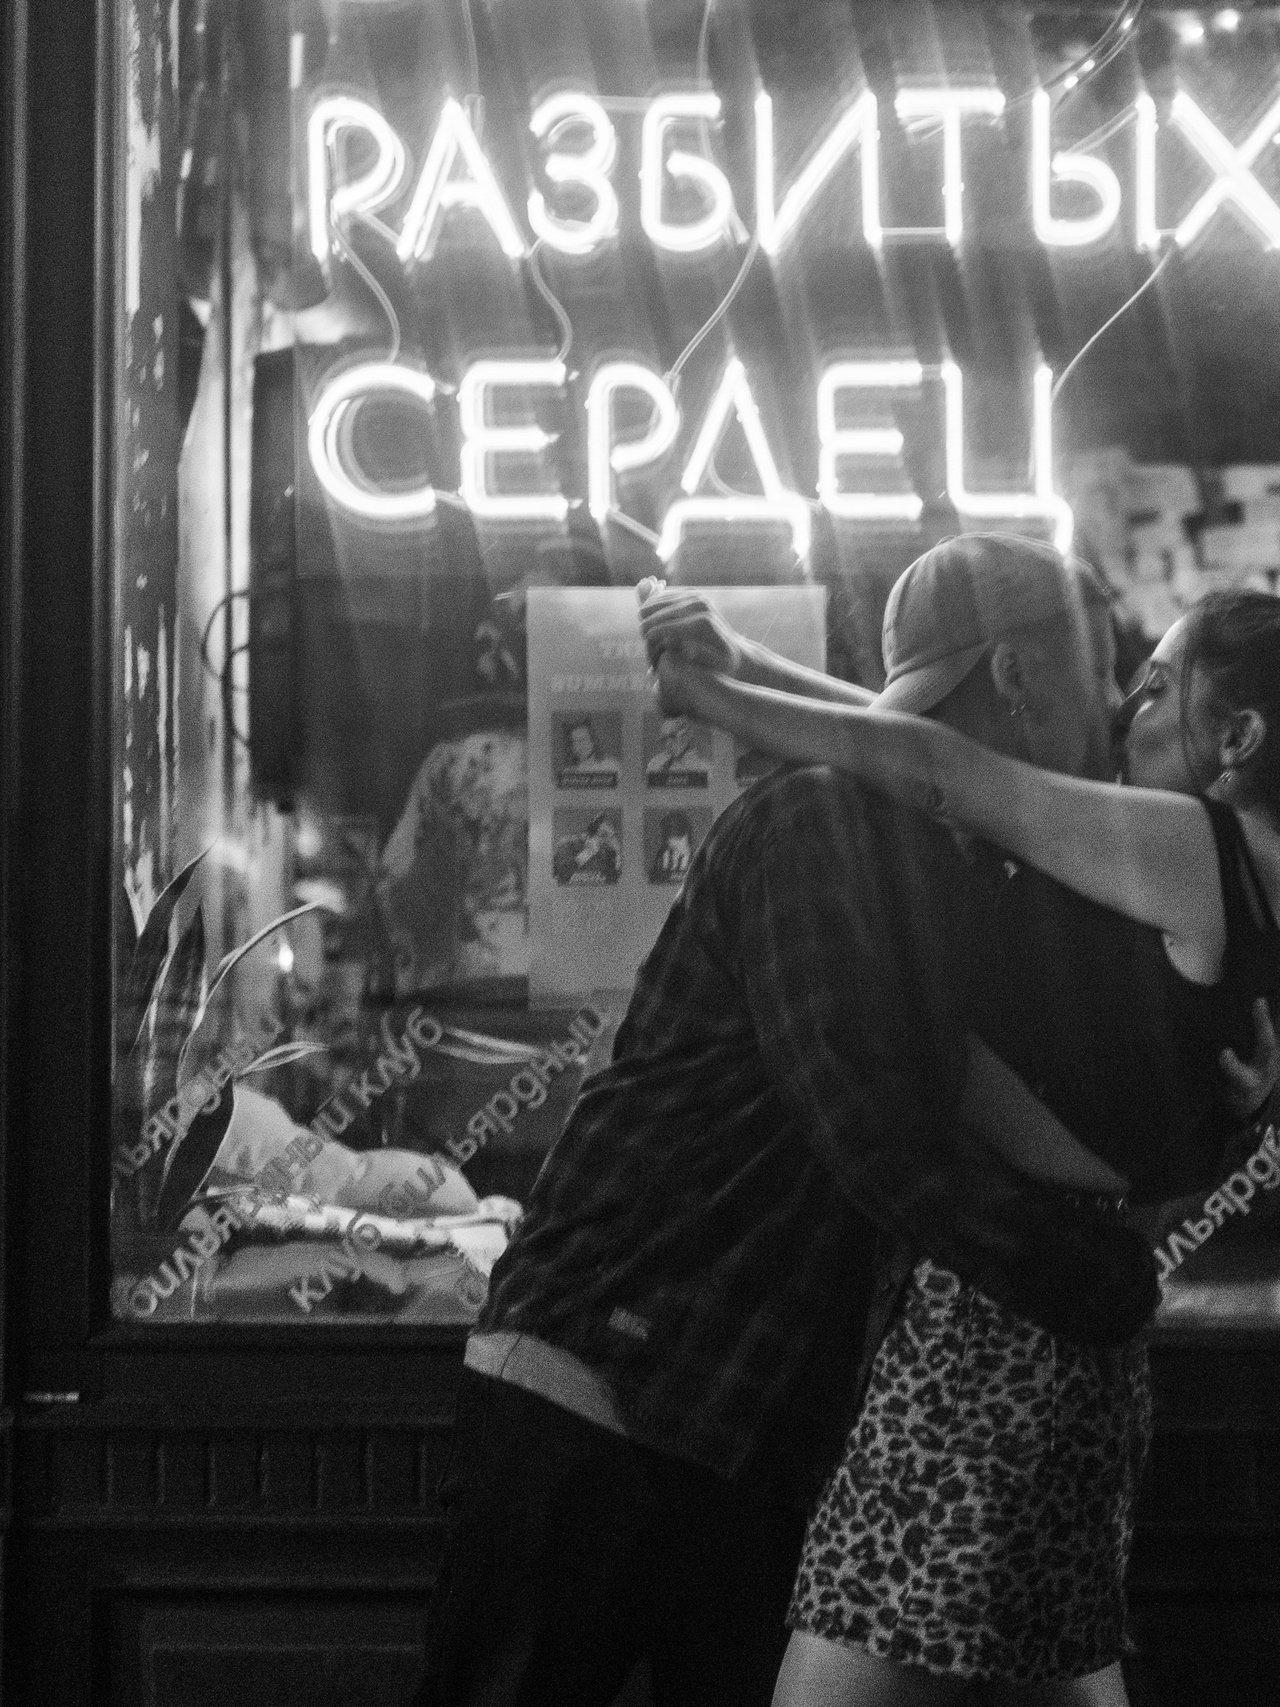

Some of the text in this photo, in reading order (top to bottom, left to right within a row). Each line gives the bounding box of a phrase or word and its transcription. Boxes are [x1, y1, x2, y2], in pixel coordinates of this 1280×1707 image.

[307, 358, 1073, 556] СЕРДЕЦ
[350, 1006, 443, 1110] клуб
[288, 1208, 382, 1314] клуб
